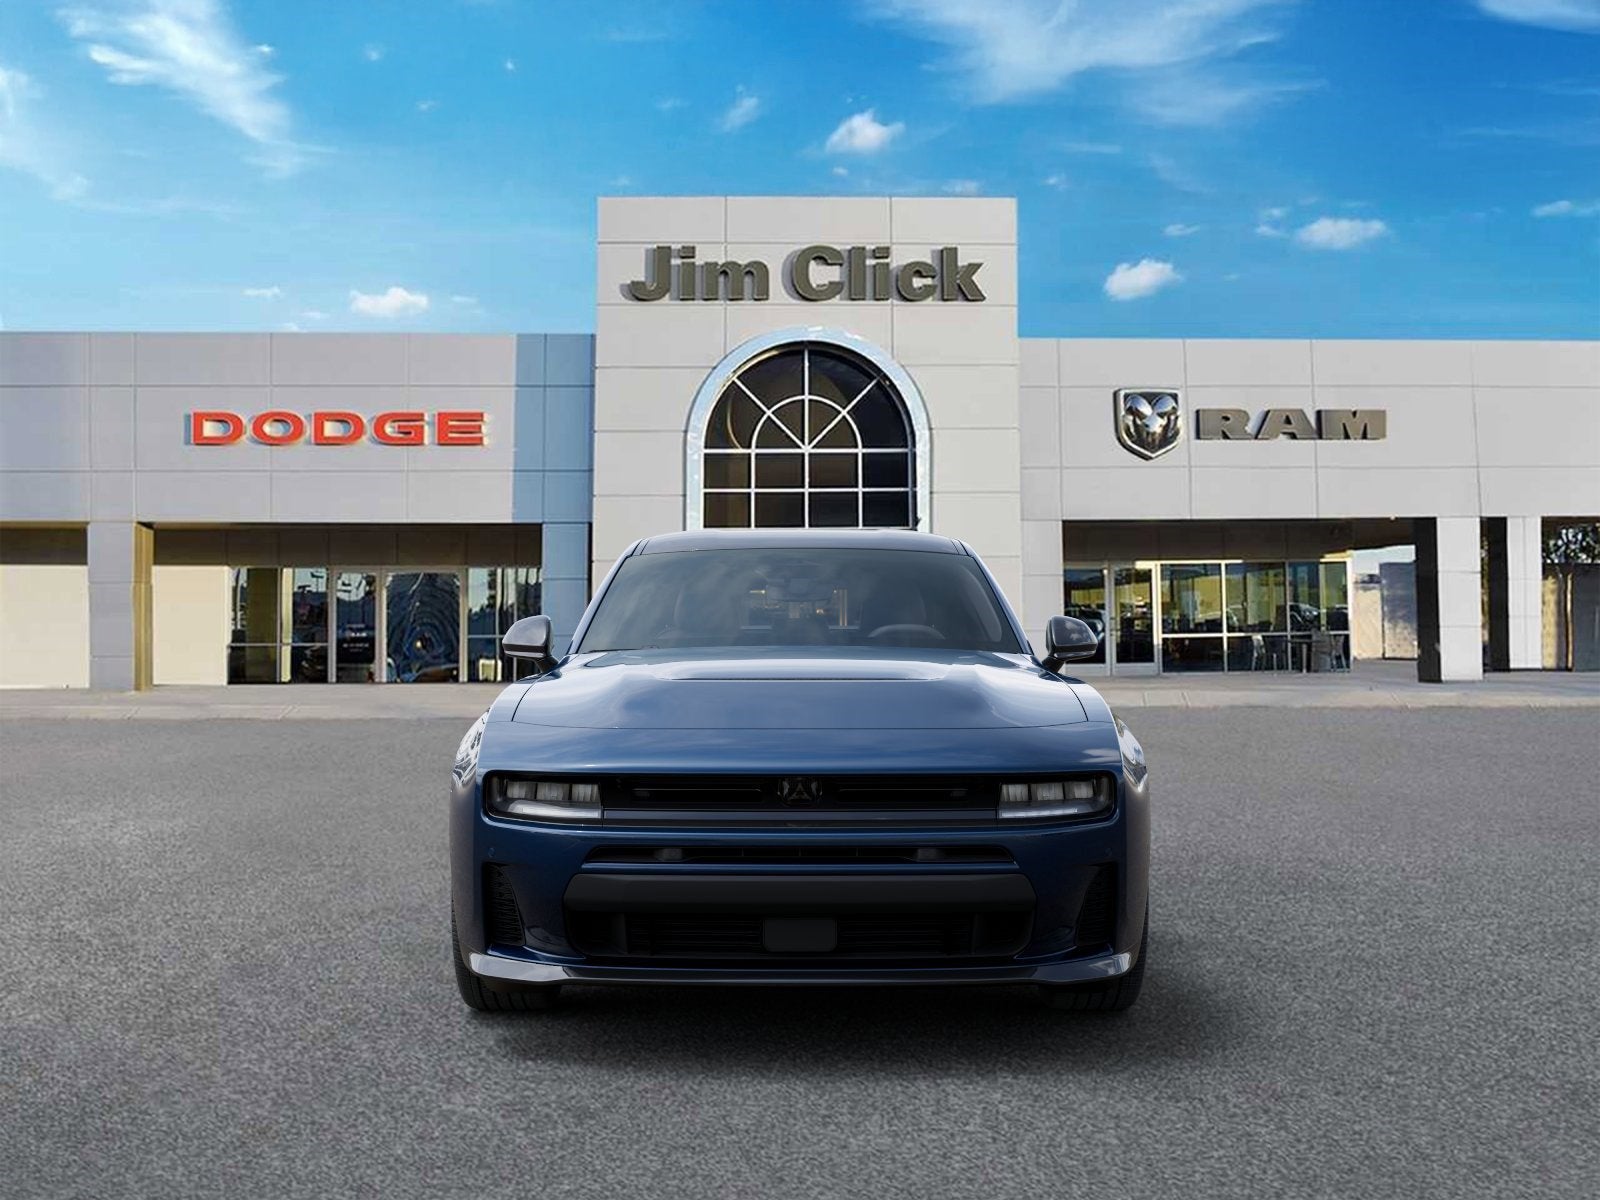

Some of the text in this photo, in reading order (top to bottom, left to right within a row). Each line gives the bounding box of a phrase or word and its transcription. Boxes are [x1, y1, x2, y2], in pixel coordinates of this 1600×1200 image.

[626, 244, 987, 302] Jim Click
[189, 410, 486, 446] DODGE
[1195, 408, 1387, 440] RAM
